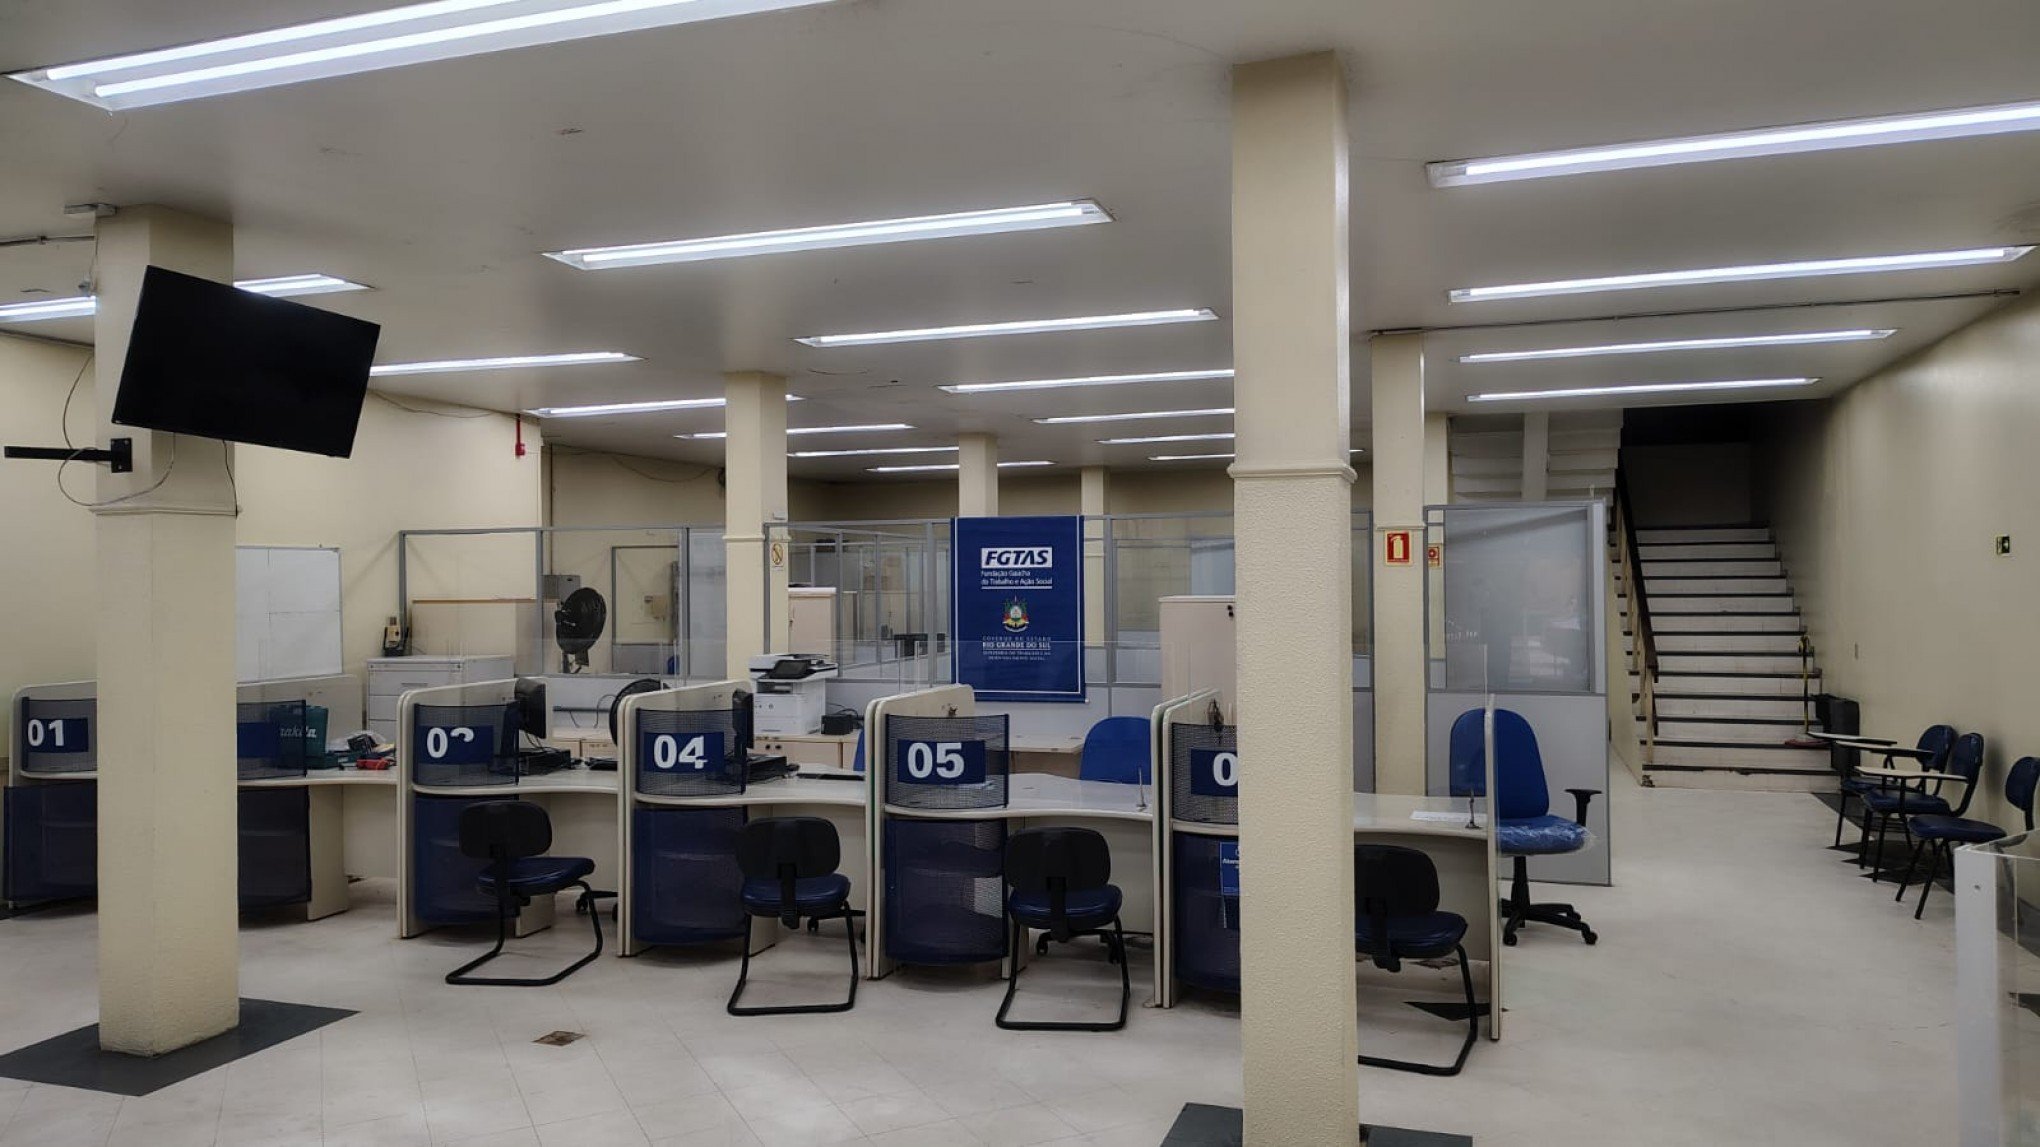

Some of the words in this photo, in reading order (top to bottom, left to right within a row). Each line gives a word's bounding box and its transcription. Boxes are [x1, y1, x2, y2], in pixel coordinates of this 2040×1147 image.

[985, 550, 1049, 565] FGTAS
[27, 719, 65, 747] 01
[280, 725, 317, 738] makta
[653, 734, 708, 770] 04
[907, 742, 965, 779] 05
[1213, 752, 1239, 787] 0
